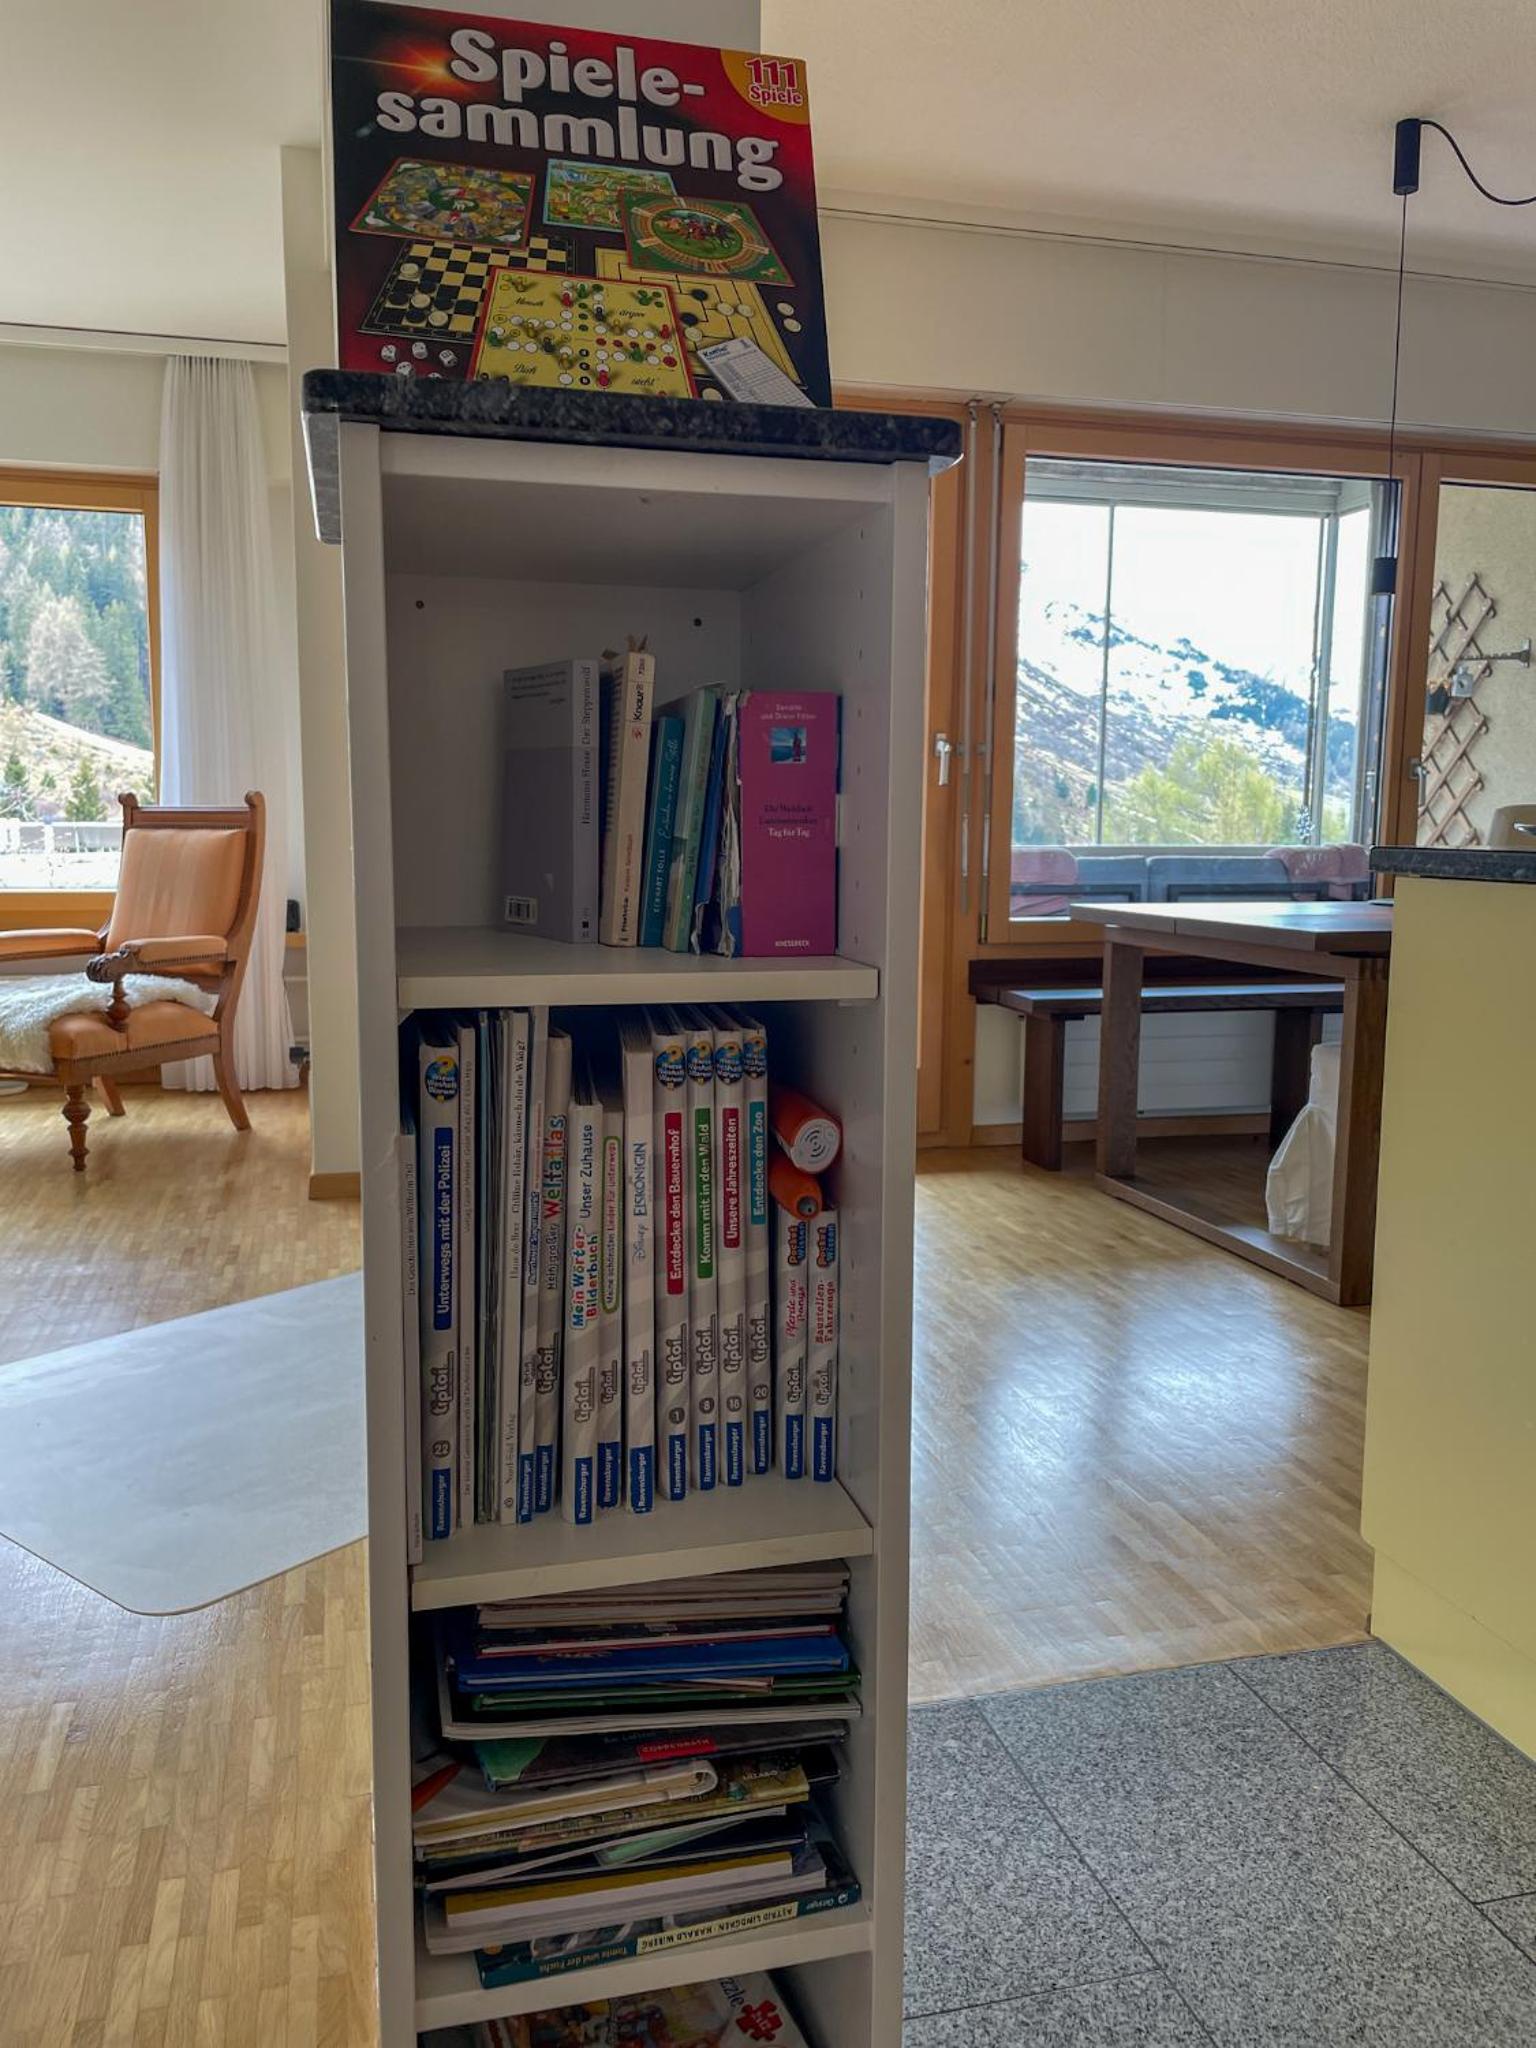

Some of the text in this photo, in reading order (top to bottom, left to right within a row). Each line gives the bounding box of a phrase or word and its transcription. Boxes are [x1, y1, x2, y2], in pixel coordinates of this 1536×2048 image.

[450, 28, 705, 106] Spiele-
[745, 58, 797, 90] 111
[749, 84, 803, 107] Spiele
[376, 91, 783, 191] sammlung
[580, 667, 593, 723] Steppenwolf
[543, 1115, 565, 1219] Weltatlas
[580, 1124, 593, 1218] Unser Zuhause
[726, 1118, 737, 1239] Unsere Jahreszeiten
[753, 1111, 764, 1216] Entdecke den Zoo
[669, 1128, 682, 1280] Entdecke den Bauernhof
[699, 1123, 711, 1264] Komm mit in den Wald
[437, 1145, 452, 1314] Unterwegs mit der Polizei
[788, 1225, 799, 1265] Pocket
[797, 1222, 806, 1259] Wissen
[817, 1227, 827, 1267] Pocket
[826, 1223, 836, 1262] Wissen
[572, 1227, 586, 1328] Mein Wörter-
[586, 1235, 599, 1317] Bilderbuch
[750, 1317, 768, 1362] tiptoi
[786, 1300, 798, 1338] Pferde
[536, 1347, 556, 1394] tiptoi
[666, 1339, 685, 1384] tiptoi
[695, 1330, 716, 1374] tiptoi
[723, 1328, 742, 1373] tiptoi
[430, 1367, 453, 1415] tiptoi
[574, 1380, 592, 1422] tiptoi
[600, 1369, 614, 1404] tiptoi
[631, 1360, 646, 1395] tiptoi
[787, 1368, 803, 1402] tiptoi
[815, 1369, 831, 1405] tiptoi
[673, 1440, 682, 1493] Ravensburger
[703, 1429, 712, 1482] Ravensburger
[730, 1428, 740, 1480] Ravensburger
[757, 1415, 766, 1467] Ravensburger
[790, 1420, 800, 1472] Ravensburger
[818, 1422, 829, 1475] Ravensburger
[539, 1451, 549, 1506] Ravensburger
[578, 1463, 589, 1519] Ravensburger
[603, 1448, 612, 1502] Ravensburger
[637, 1452, 646, 1507] Ravensburger
[436, 1474, 447, 1531] Ravensburger
